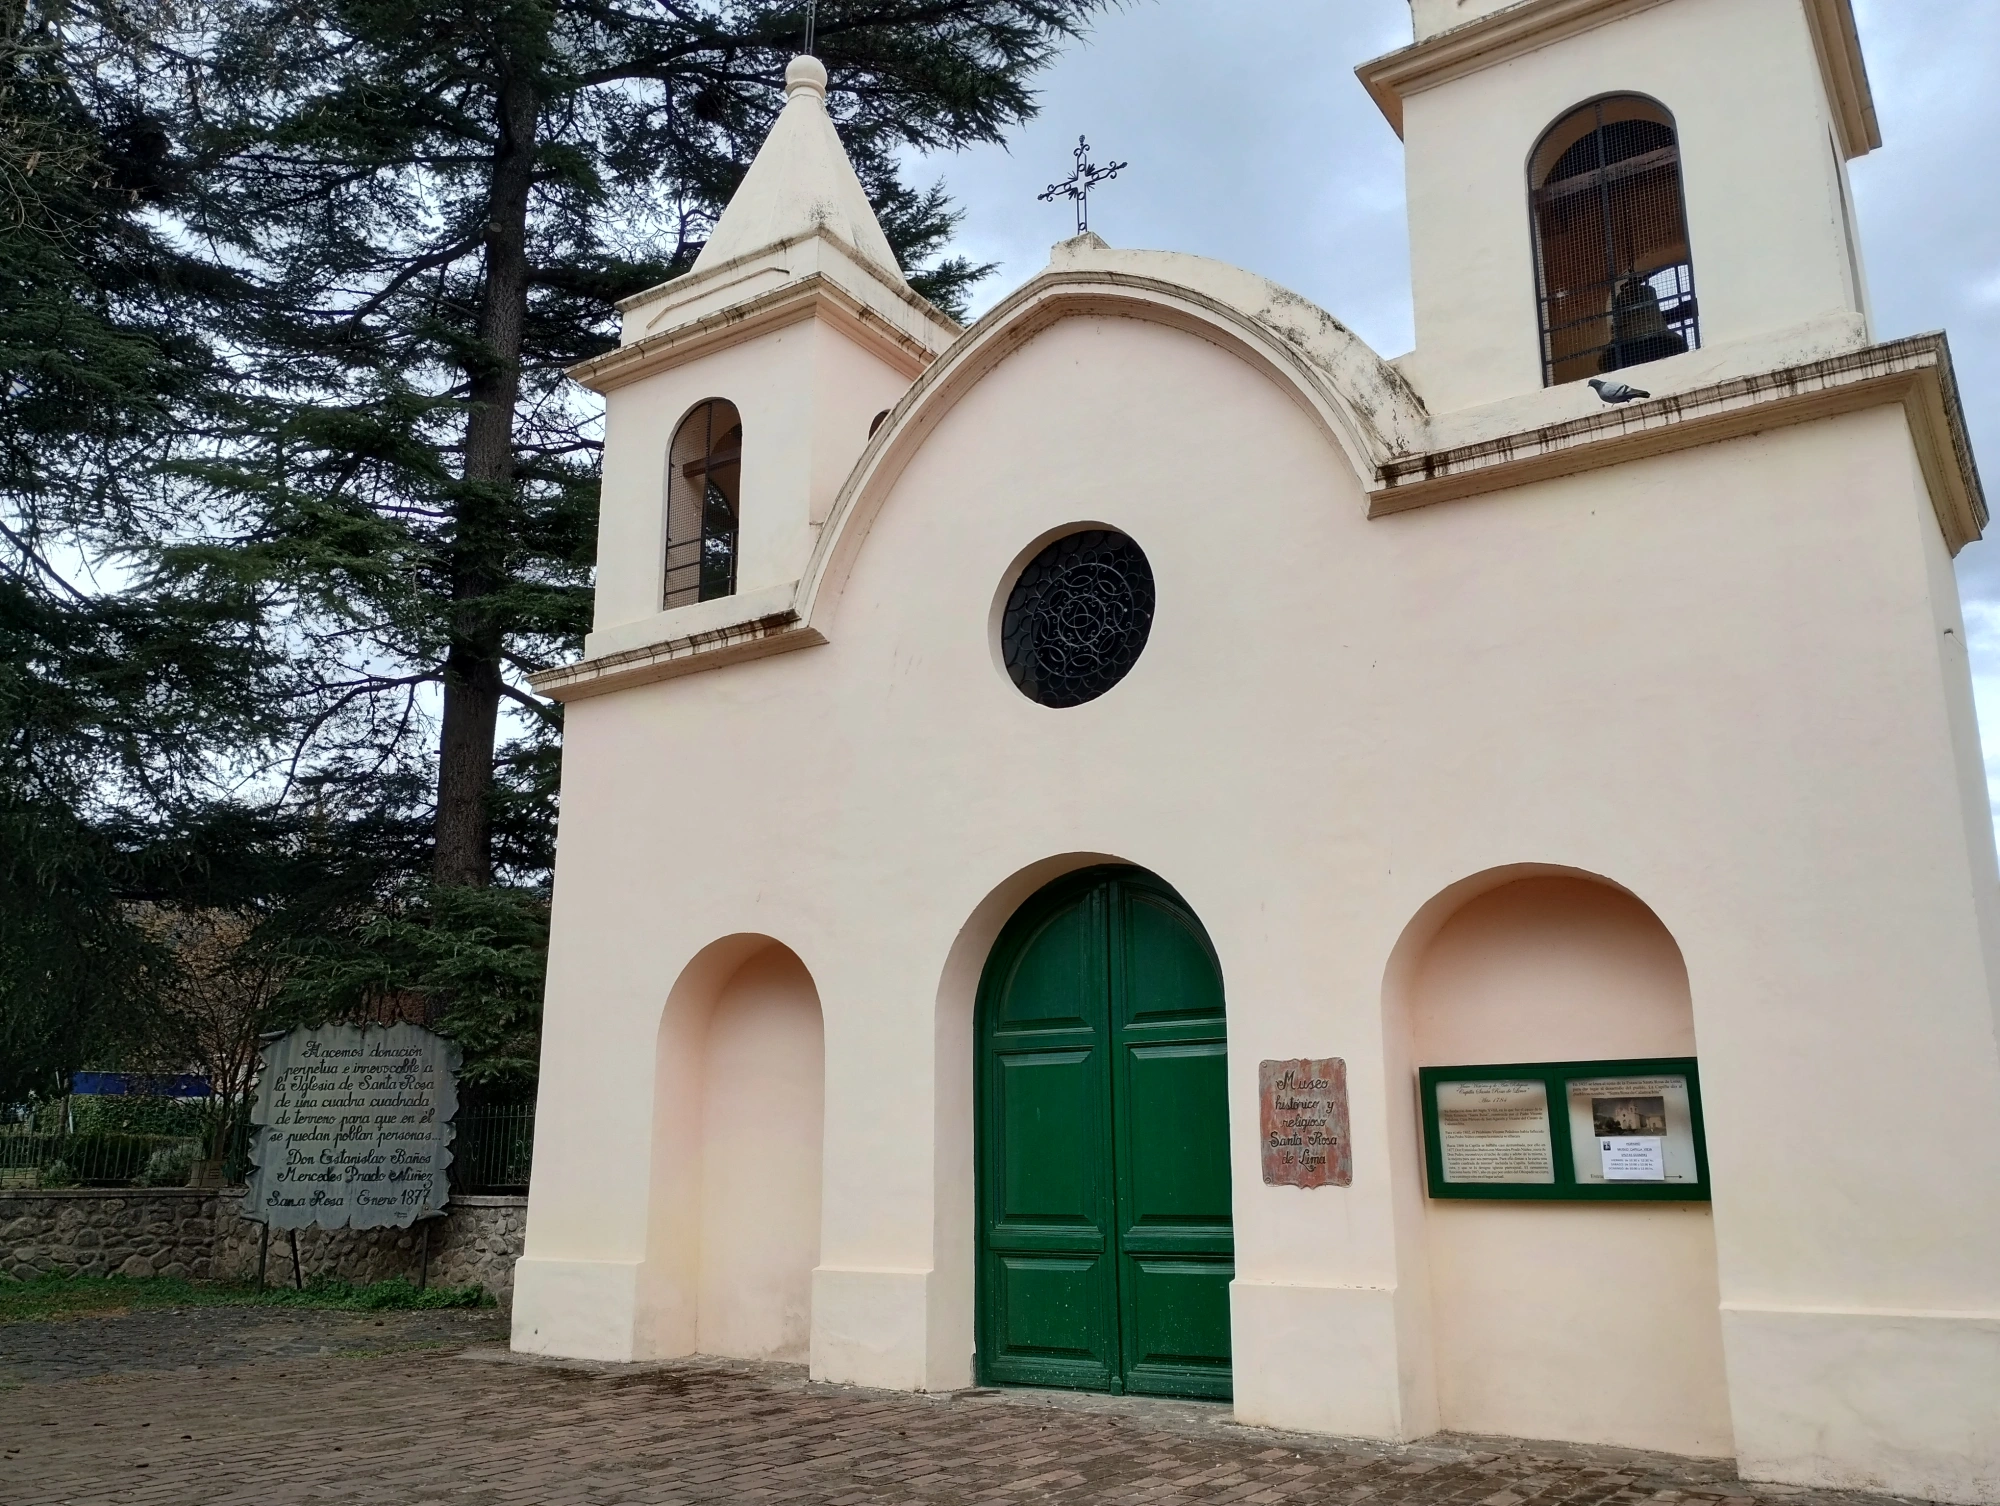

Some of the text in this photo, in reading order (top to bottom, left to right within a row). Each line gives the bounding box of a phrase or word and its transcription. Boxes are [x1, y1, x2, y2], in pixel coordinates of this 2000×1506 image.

[301, 1041, 422, 1058] Hacemos donación
[284, 1059, 338, 1081] perpetua
[352, 1058, 419, 1073] irrevocable
[273, 1074, 434, 1098] la Iglesia de Santa Rosa
[1276, 1070, 1328, 1090] Museo
[274, 1092, 430, 1107] de una cuadra cuadrada
[1276, 1095, 1334, 1113] histórico y
[275, 1110, 290, 1124] de
[294, 1109, 336, 1124] terreno
[339, 1114, 370, 1130] para
[374, 1114, 396, 1130] que
[400, 1115, 414, 1123] en
[1282, 1114, 1326, 1131] religioso
[268, 1133, 283, 1141] se
[285, 1126, 330, 1148] puedan
[333, 1126, 373, 1148] poblar
[1269, 1131, 1337, 1147] Santa Rosa
[287, 1149, 431, 1165] Don Estanislao Baños
[1282, 1149, 1326, 1172] de Lima
[277, 1166, 342, 1182] Mercedes
[345, 1166, 386, 1183] Prado
[310, 1190, 343, 1206] Rosa
[356, 1190, 397, 1205] Enero
[401, 1189, 431, 1205] 1877
